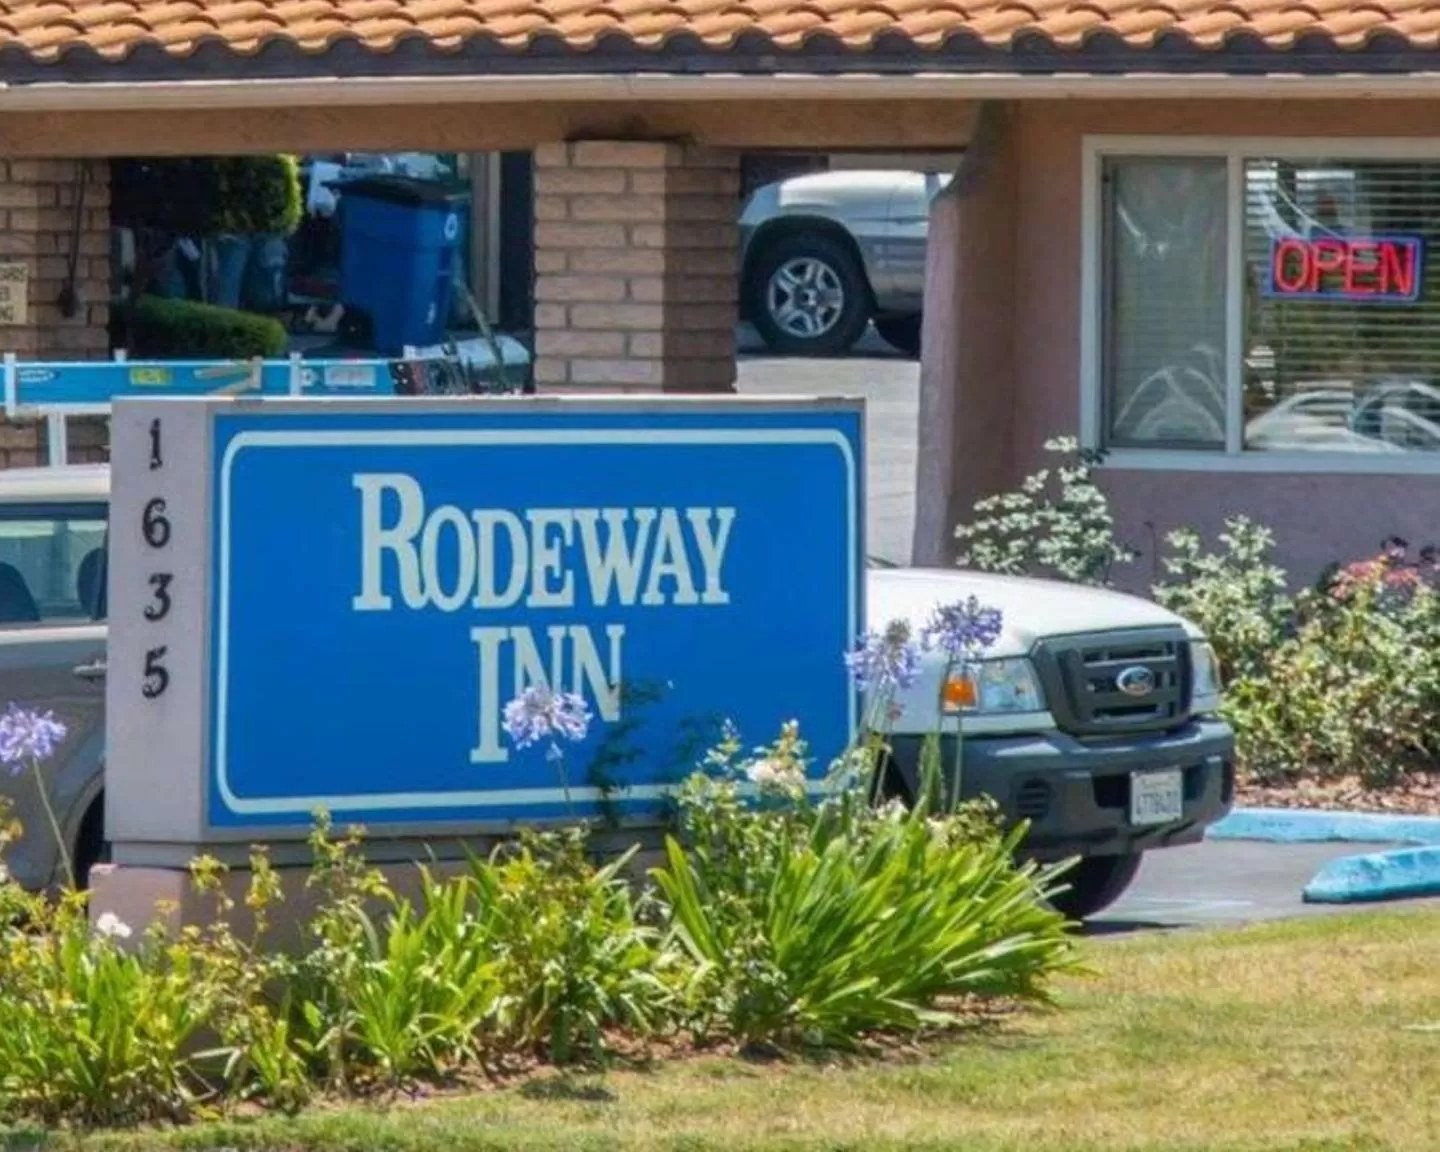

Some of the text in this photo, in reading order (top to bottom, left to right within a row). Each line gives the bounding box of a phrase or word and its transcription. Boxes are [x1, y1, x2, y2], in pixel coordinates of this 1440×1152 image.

[1275, 239, 1415, 295] OPEN
[141, 416, 174, 700] 1635
[352, 472, 737, 613] RODEWAY
[469, 623, 626, 764] INN
